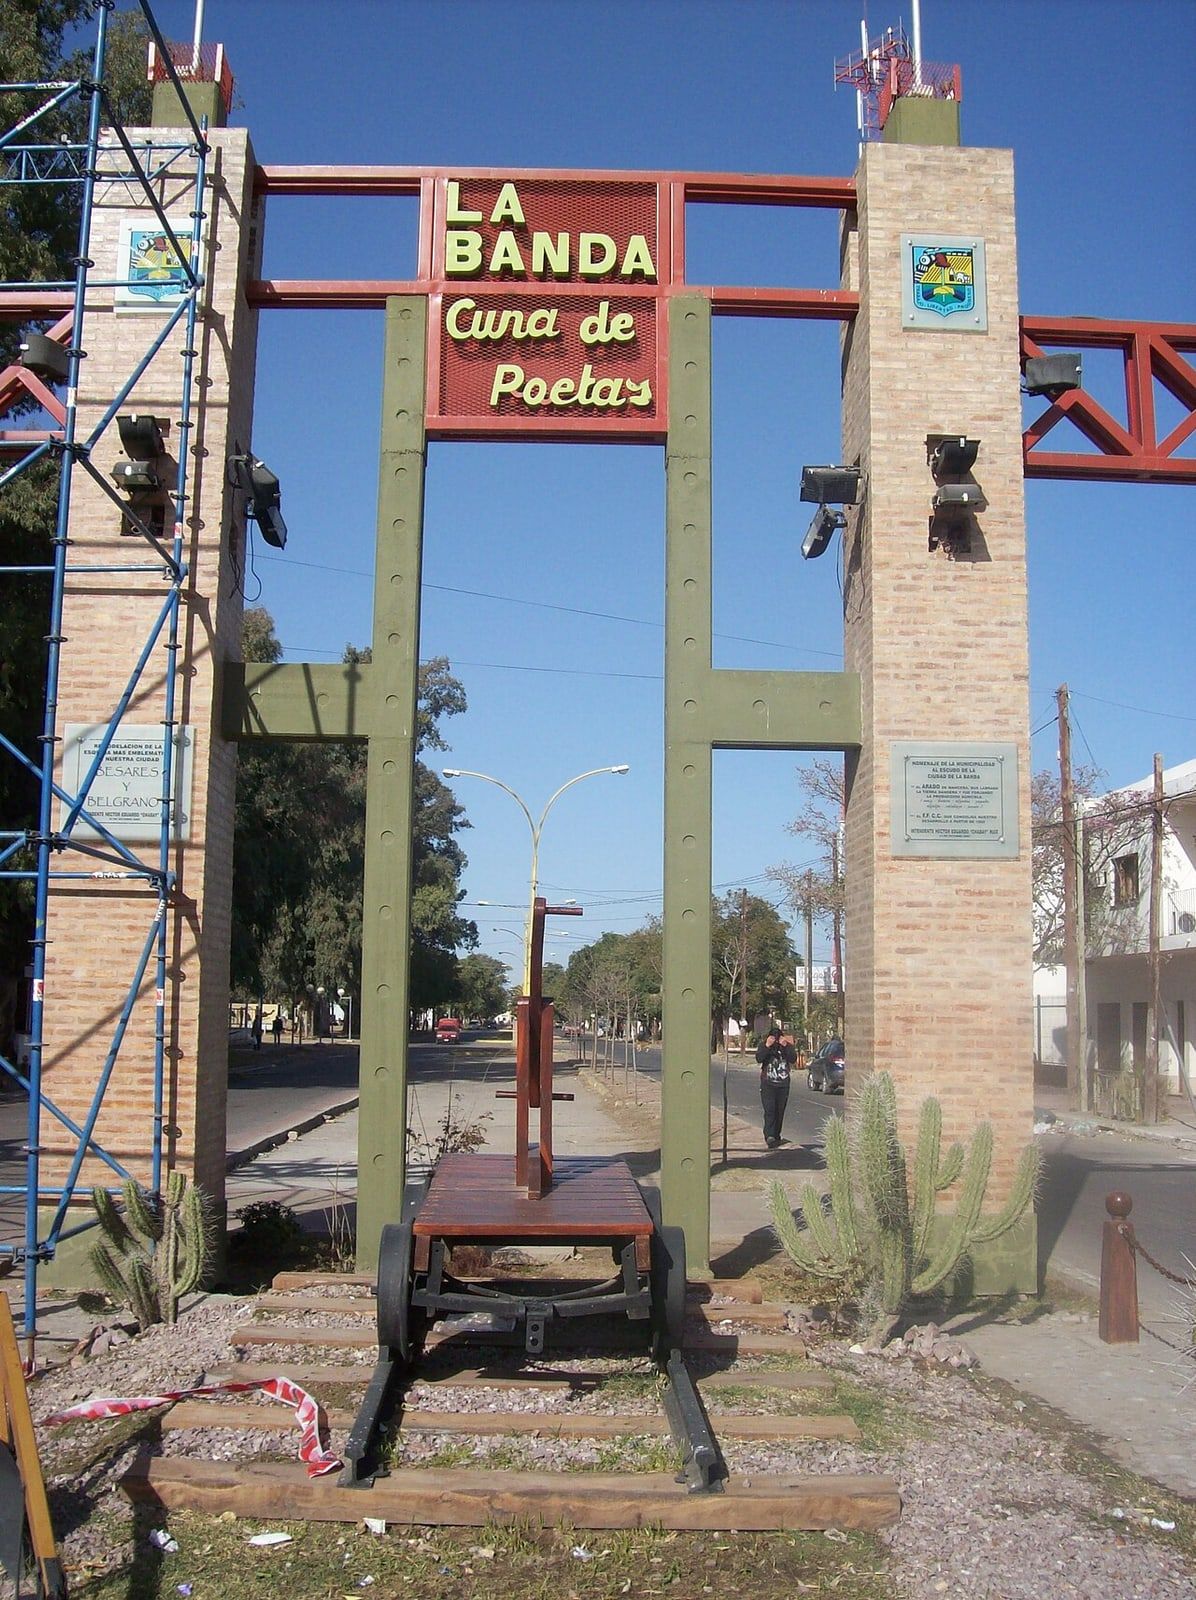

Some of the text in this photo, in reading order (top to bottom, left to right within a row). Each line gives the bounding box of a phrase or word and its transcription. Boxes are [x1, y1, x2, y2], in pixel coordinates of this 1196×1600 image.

[446, 182, 525, 224] LA
[445, 231, 656, 279] BANDA
[446, 298, 636, 345] Cuna de
[489, 364, 654, 408] Poetas
[88, 796, 159, 808] BELGRANO
[122, 782, 131, 792] Y
